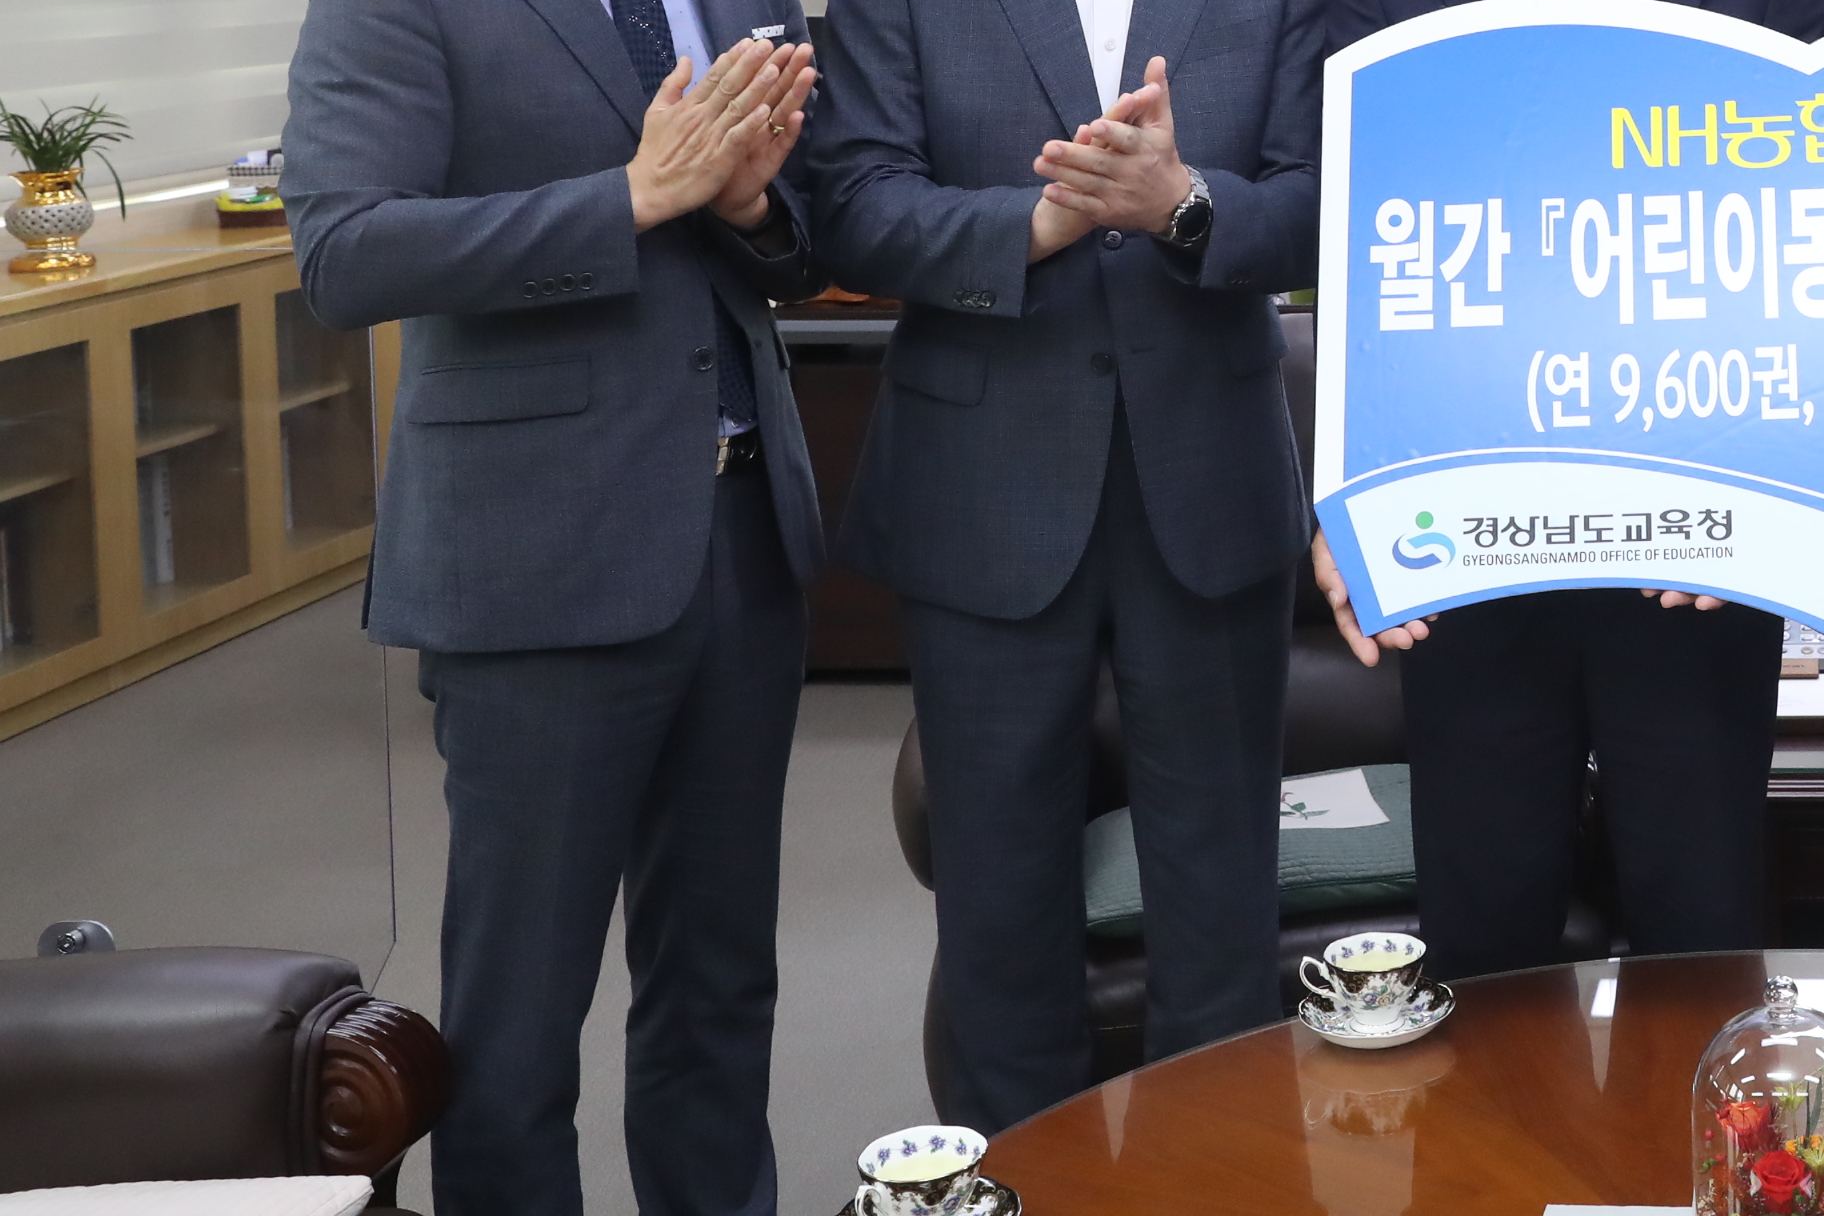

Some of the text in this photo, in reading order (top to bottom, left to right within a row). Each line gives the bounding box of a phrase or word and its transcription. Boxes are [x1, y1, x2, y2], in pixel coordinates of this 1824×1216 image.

[1369, 197, 1511, 332] 월간
[1526, 350, 1591, 433] (연
[1609, 343, 1815, 433] 9,600권,
[1462, 508, 1733, 548] 경상남도교육청
[1462, 546, 1733, 567] GYEONGSANGNAMDO OFFICE OF EDUCATION
